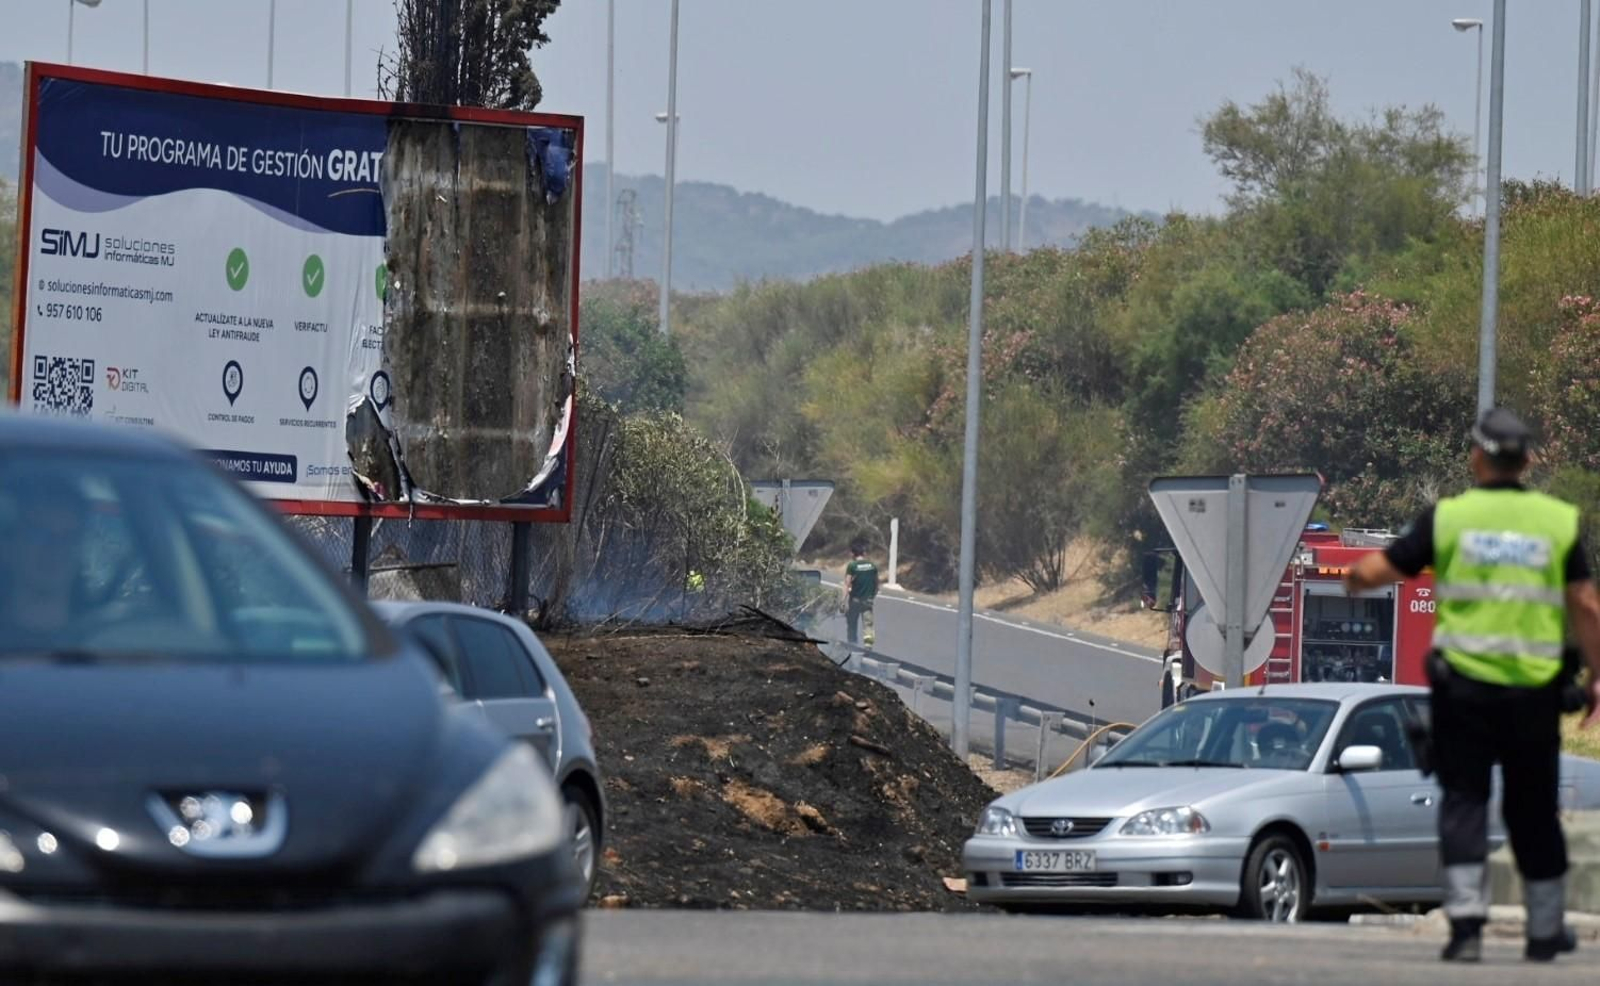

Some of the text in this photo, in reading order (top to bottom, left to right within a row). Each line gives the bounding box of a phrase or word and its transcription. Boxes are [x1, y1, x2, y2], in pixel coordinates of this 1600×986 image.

[101, 131, 123, 158] TU
[128, 134, 222, 170] PROGRAMA
[227, 146, 248, 172] DE
[252, 148, 324, 180] GESTIÓN
[105, 236, 176, 254] soluciones
[104, 250, 175, 267] informáticas MJ
[47, 279, 174, 304] solucionesinformaticasmj.com
[46, 303, 102, 322] 957 610 106
[195, 312, 237, 326] ACTUALÍZATE
[253, 318, 274, 328] NUEVA
[208, 329, 260, 342] LEY ANTIFRAUDE
[295, 322, 328, 333] VERIFACTU
[122, 368, 139, 379] KIT
[252, 461, 262, 473] TU
[263, 461, 293, 476] AYUDA
[1025, 852, 1060, 869] 6337
